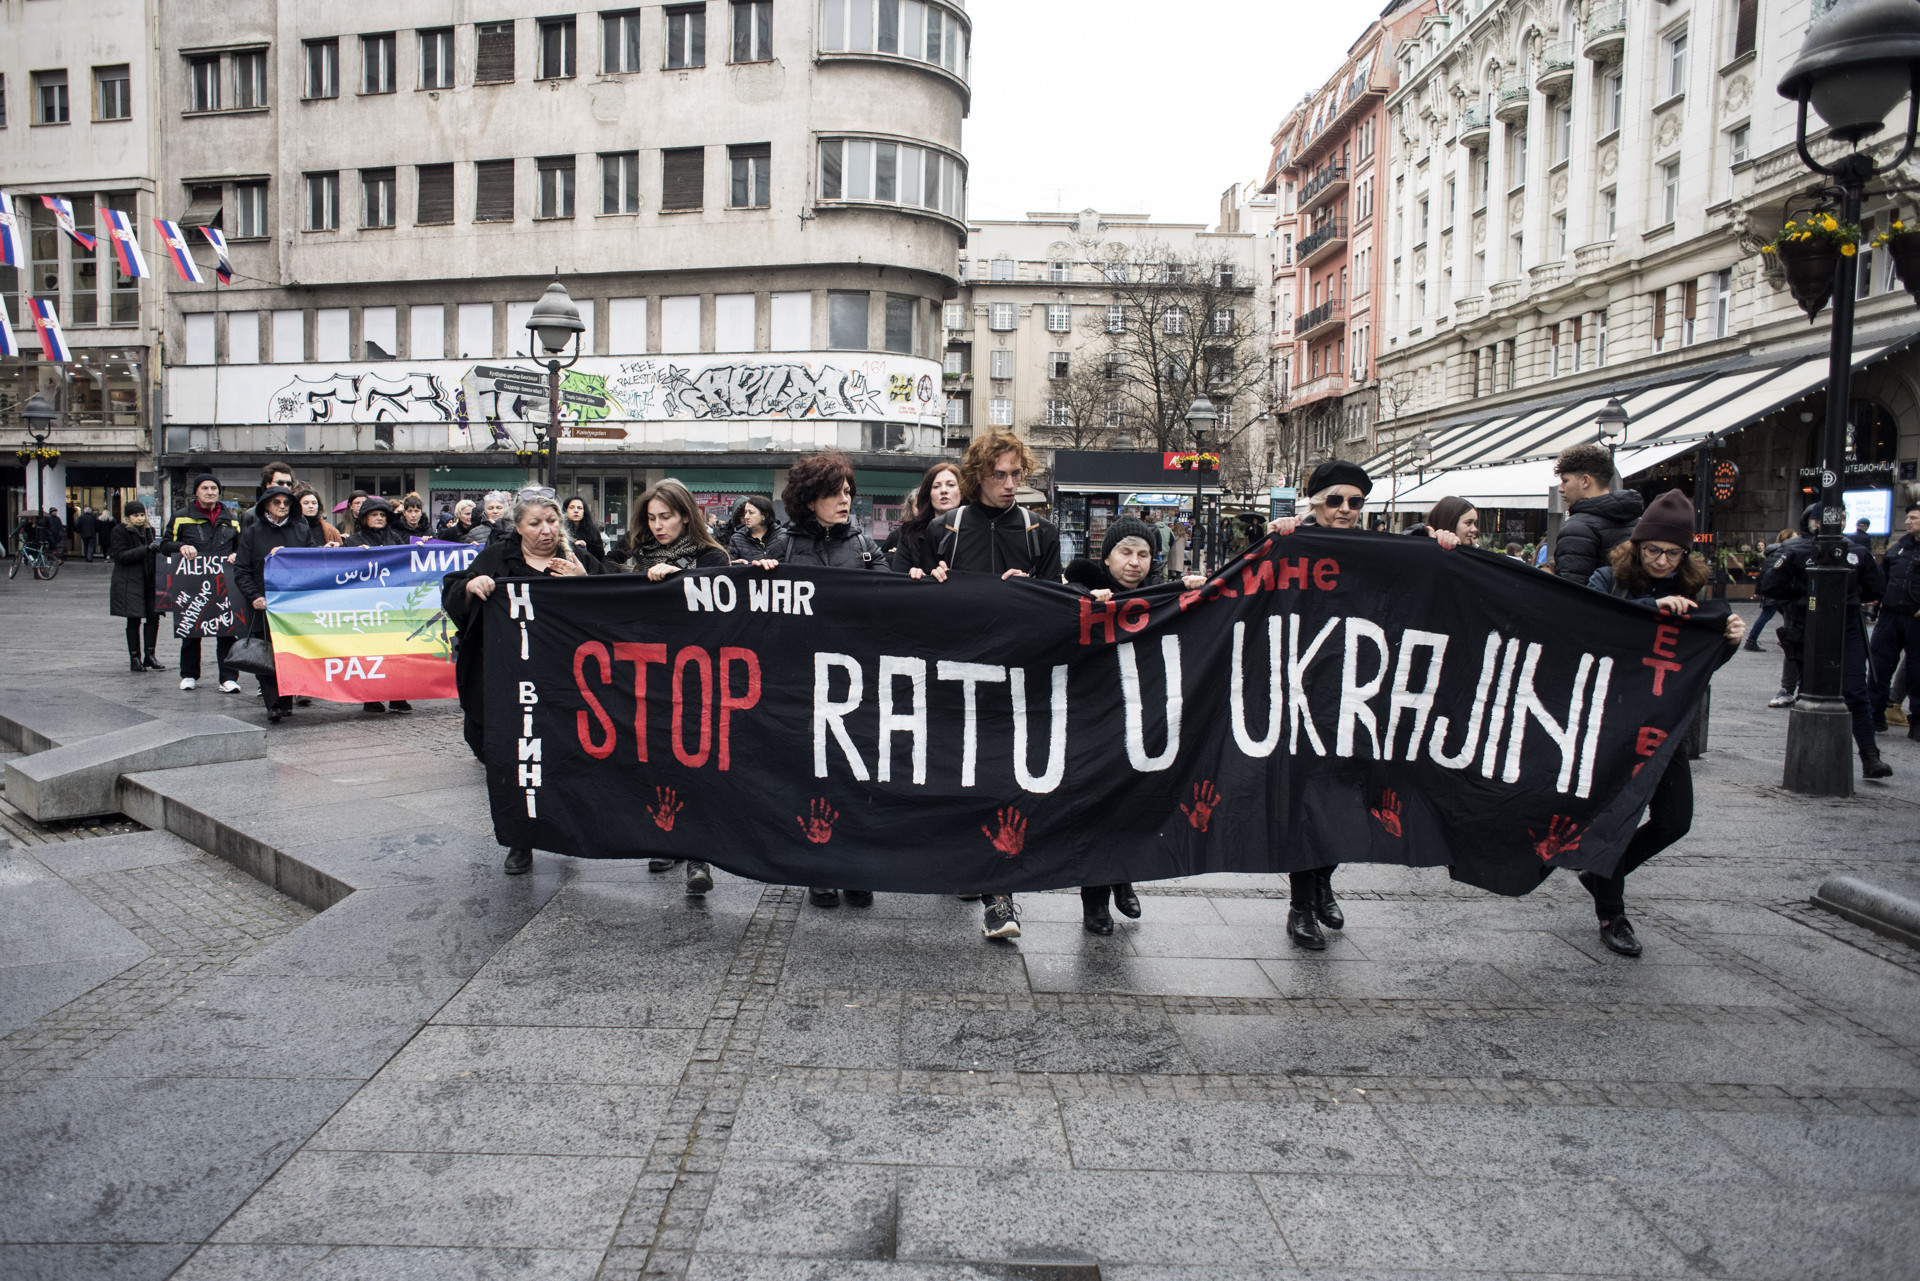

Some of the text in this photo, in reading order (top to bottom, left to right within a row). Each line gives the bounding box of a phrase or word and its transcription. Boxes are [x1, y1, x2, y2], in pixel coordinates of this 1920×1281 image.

[617, 368, 666, 386] PALESTINE
[620, 359, 656, 374] FREE
[576, 429, 607, 437] Kalemegdan
[410, 550, 479, 573] МИР
[683, 574, 815, 615] NO WAR
[324, 656, 386, 682] PAZ
[573, 613, 1612, 799] STOP RATU U UKRAJINI
